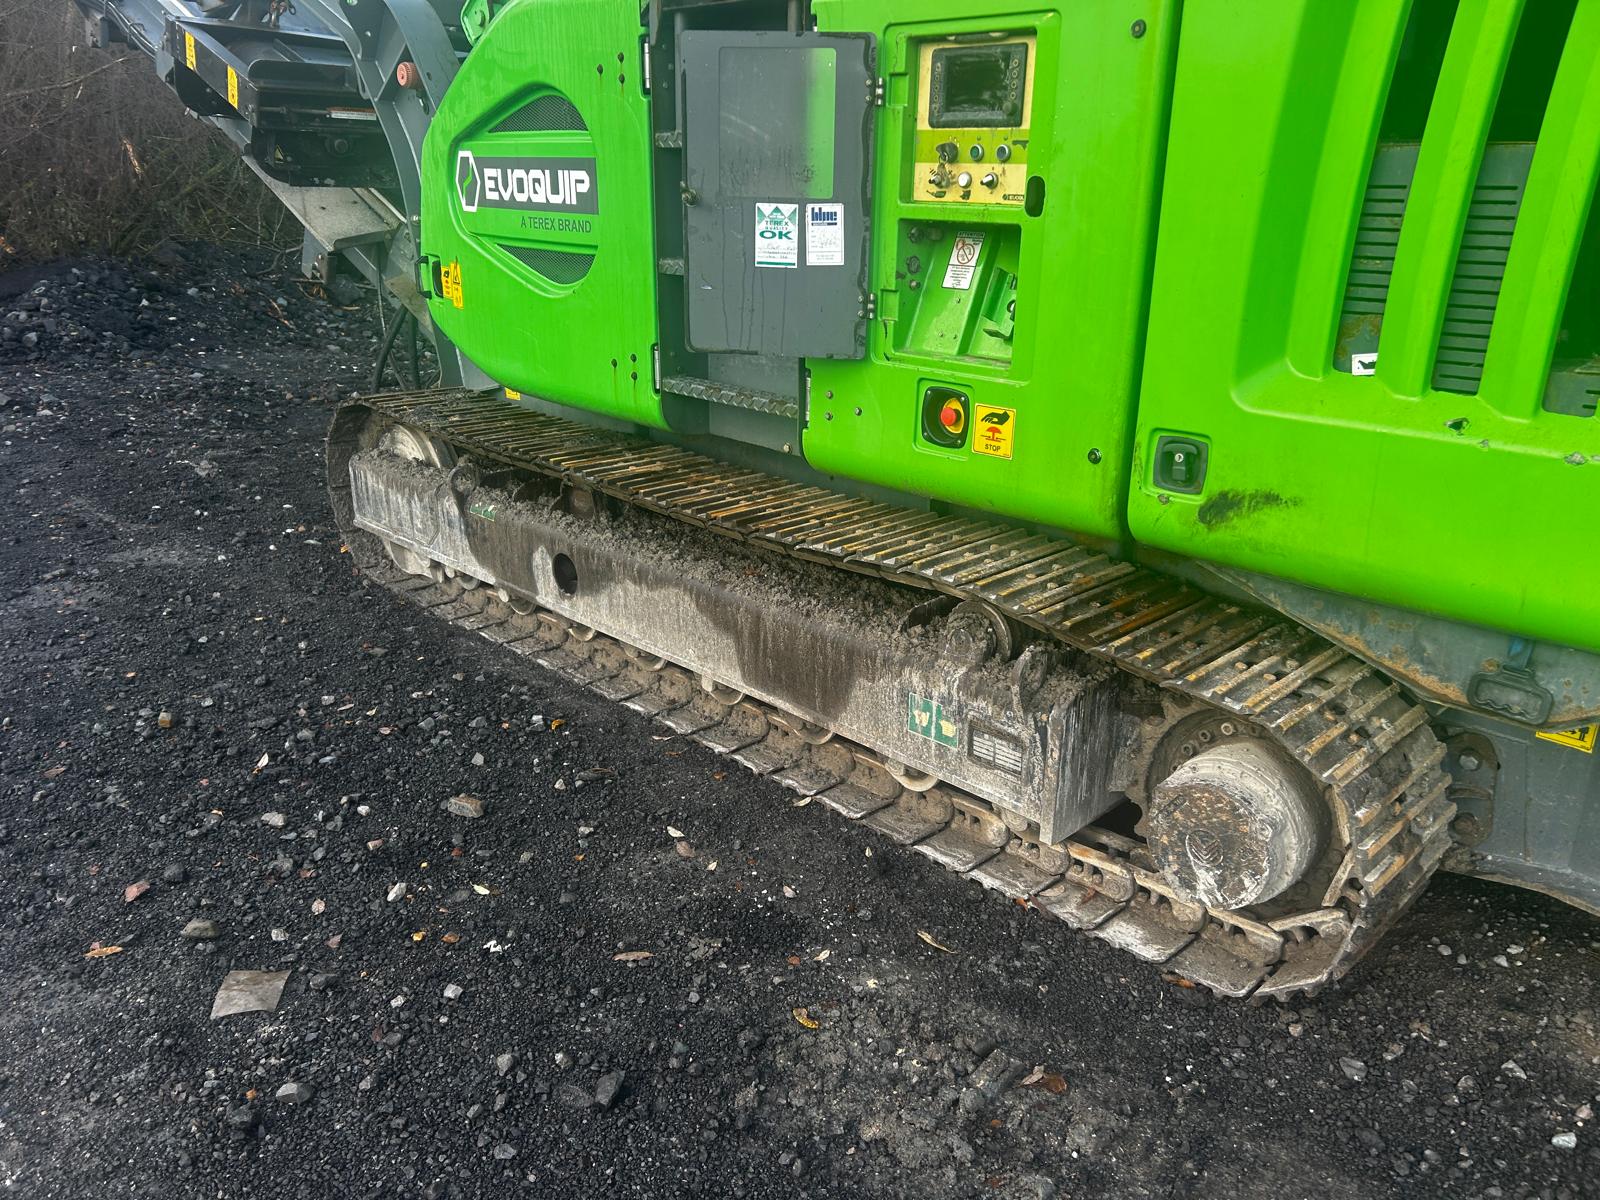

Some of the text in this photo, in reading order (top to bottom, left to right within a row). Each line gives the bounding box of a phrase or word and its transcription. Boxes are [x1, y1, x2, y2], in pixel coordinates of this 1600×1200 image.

[483, 167, 591, 205] EVOQUIP
[520, 215, 592, 233] A TEREX BRAND
[759, 230, 793, 240] OK
[984, 443, 1001, 453] STOP
